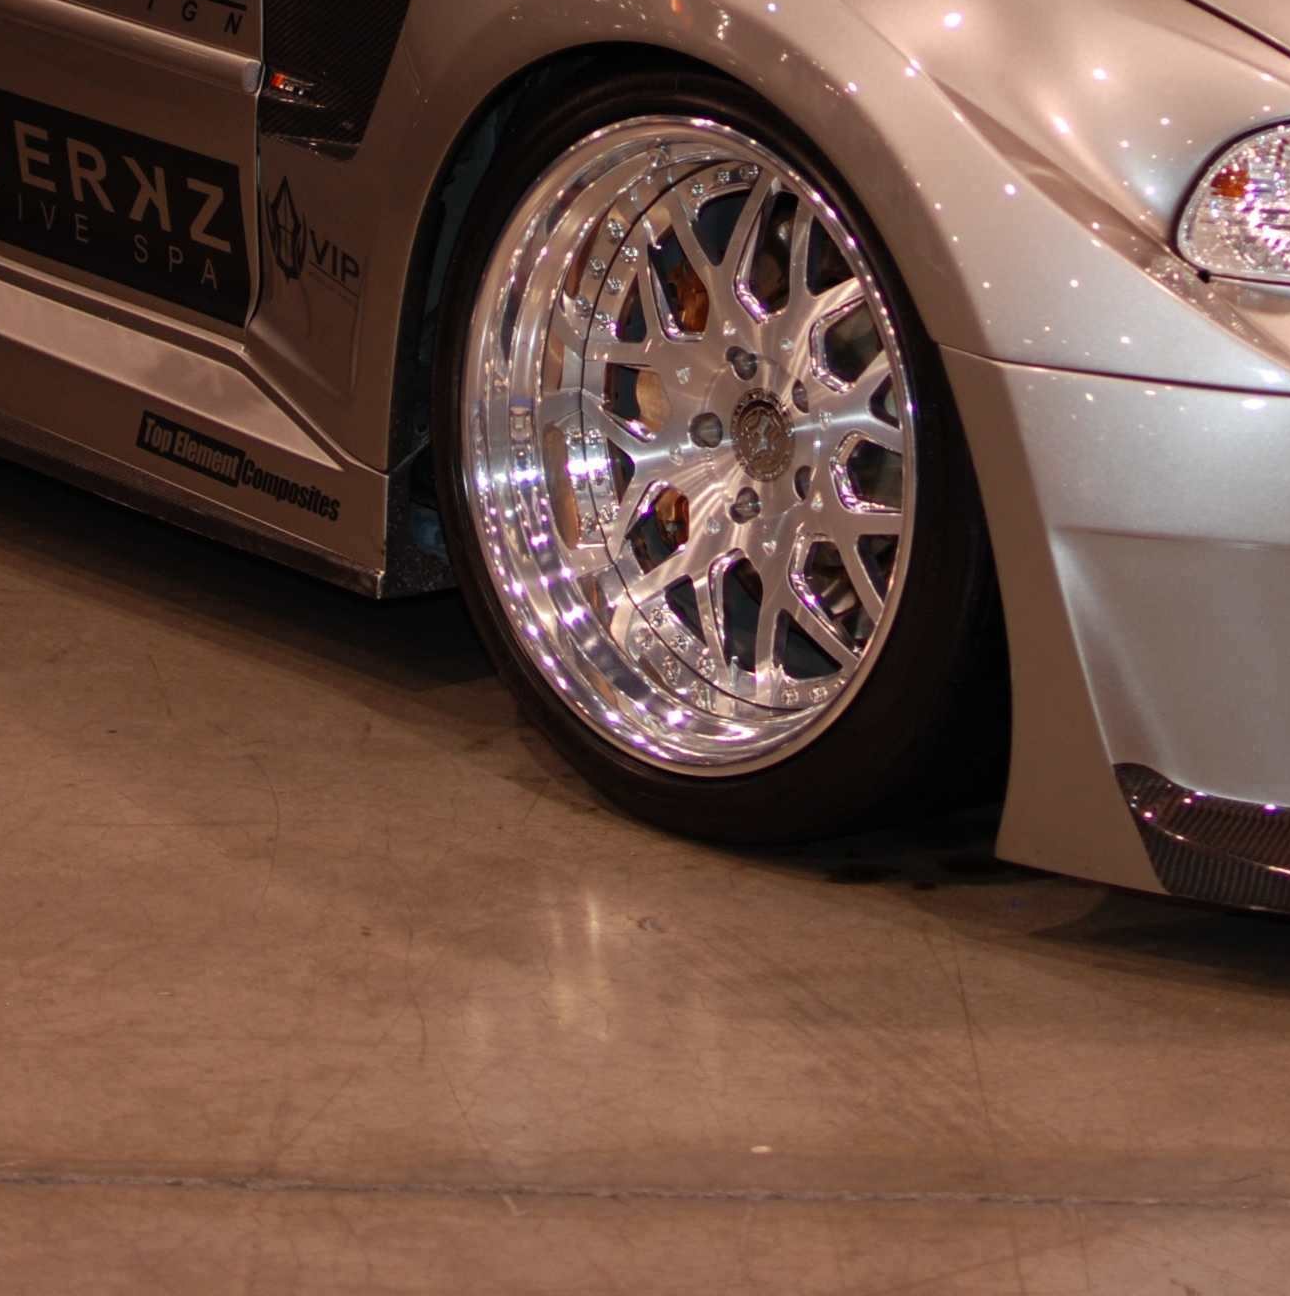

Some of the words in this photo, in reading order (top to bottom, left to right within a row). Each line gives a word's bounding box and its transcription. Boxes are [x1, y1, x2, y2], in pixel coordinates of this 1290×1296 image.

[133, 232, 219, 291] SPA
[309, 226, 360, 284] VIP
[142, 417, 172, 453] Top
[174, 430, 242, 481] Element
[241, 458, 341, 522] Composites
